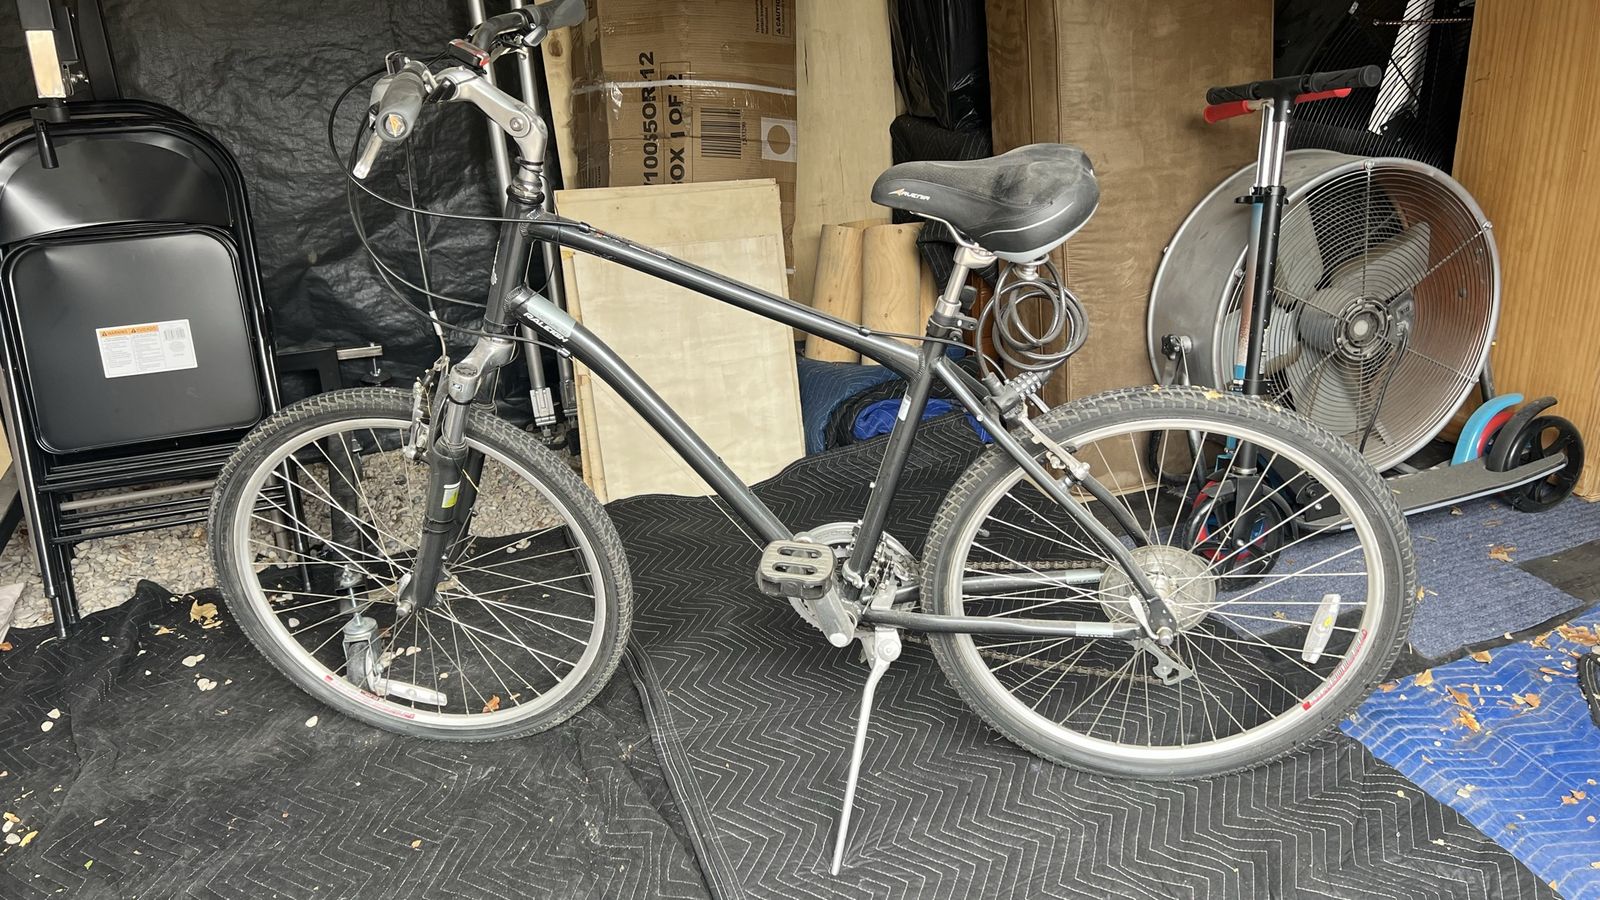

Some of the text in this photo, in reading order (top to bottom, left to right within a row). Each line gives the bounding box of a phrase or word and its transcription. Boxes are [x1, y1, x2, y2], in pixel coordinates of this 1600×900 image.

[668, 95, 684, 125] OF
[669, 147, 686, 185] OX
[523, 312, 569, 342] RALEIGH
